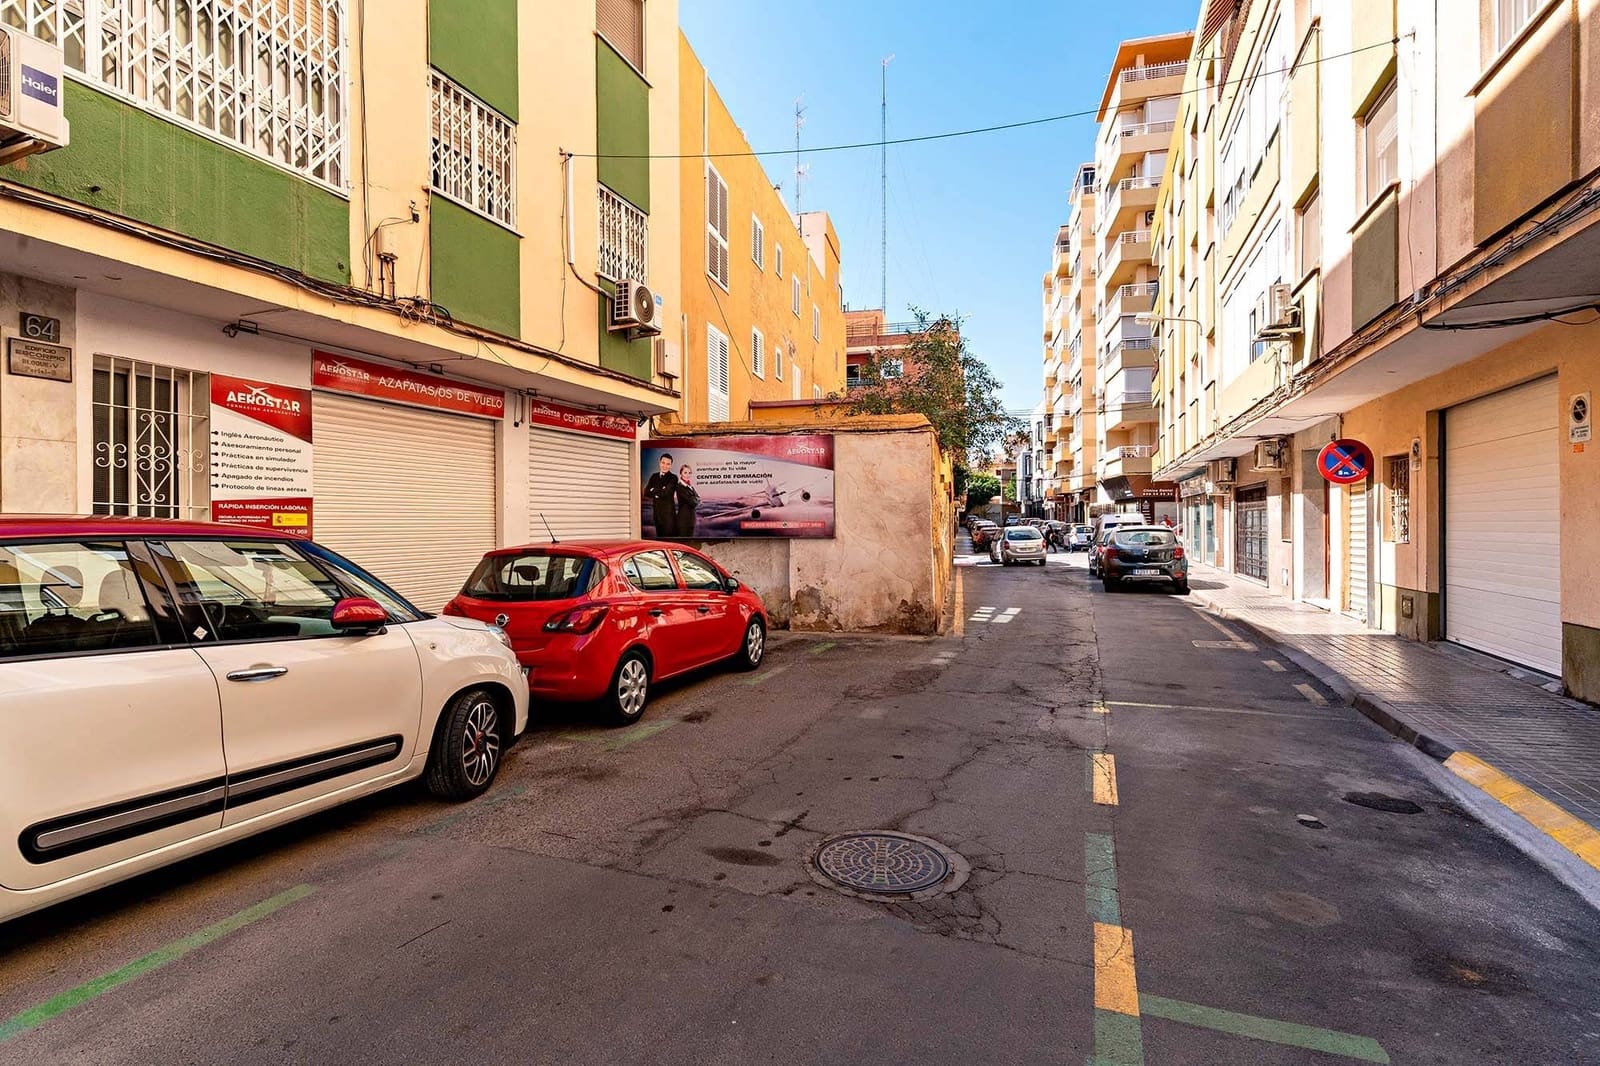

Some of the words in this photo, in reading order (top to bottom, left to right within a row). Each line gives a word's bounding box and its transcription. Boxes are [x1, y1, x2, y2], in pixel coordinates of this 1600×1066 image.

[22, 75, 56, 96] Haier
[26, 316, 55, 340] 64
[25, 345, 57, 354] EDIFICIO
[320, 363, 370, 380] AEROSTAR
[226, 391, 300, 412] AEROSTAR
[457, 391, 470, 402] DE
[473, 395, 503, 408] VUELO
[563, 413, 590, 425] CENTRO
[591, 418, 600, 427] DE
[221, 431, 242, 439] Inglés
[243, 433, 284, 443] Aeronáutico
[221, 441, 273, 452] Asesoramiento
[221, 452, 254, 461] Prácticas
[221, 462, 254, 470] Prácticas
[265, 466, 309, 474] supervivencia
[221, 473, 253, 481] Apagado
[221, 483, 255, 491] Protocolo
